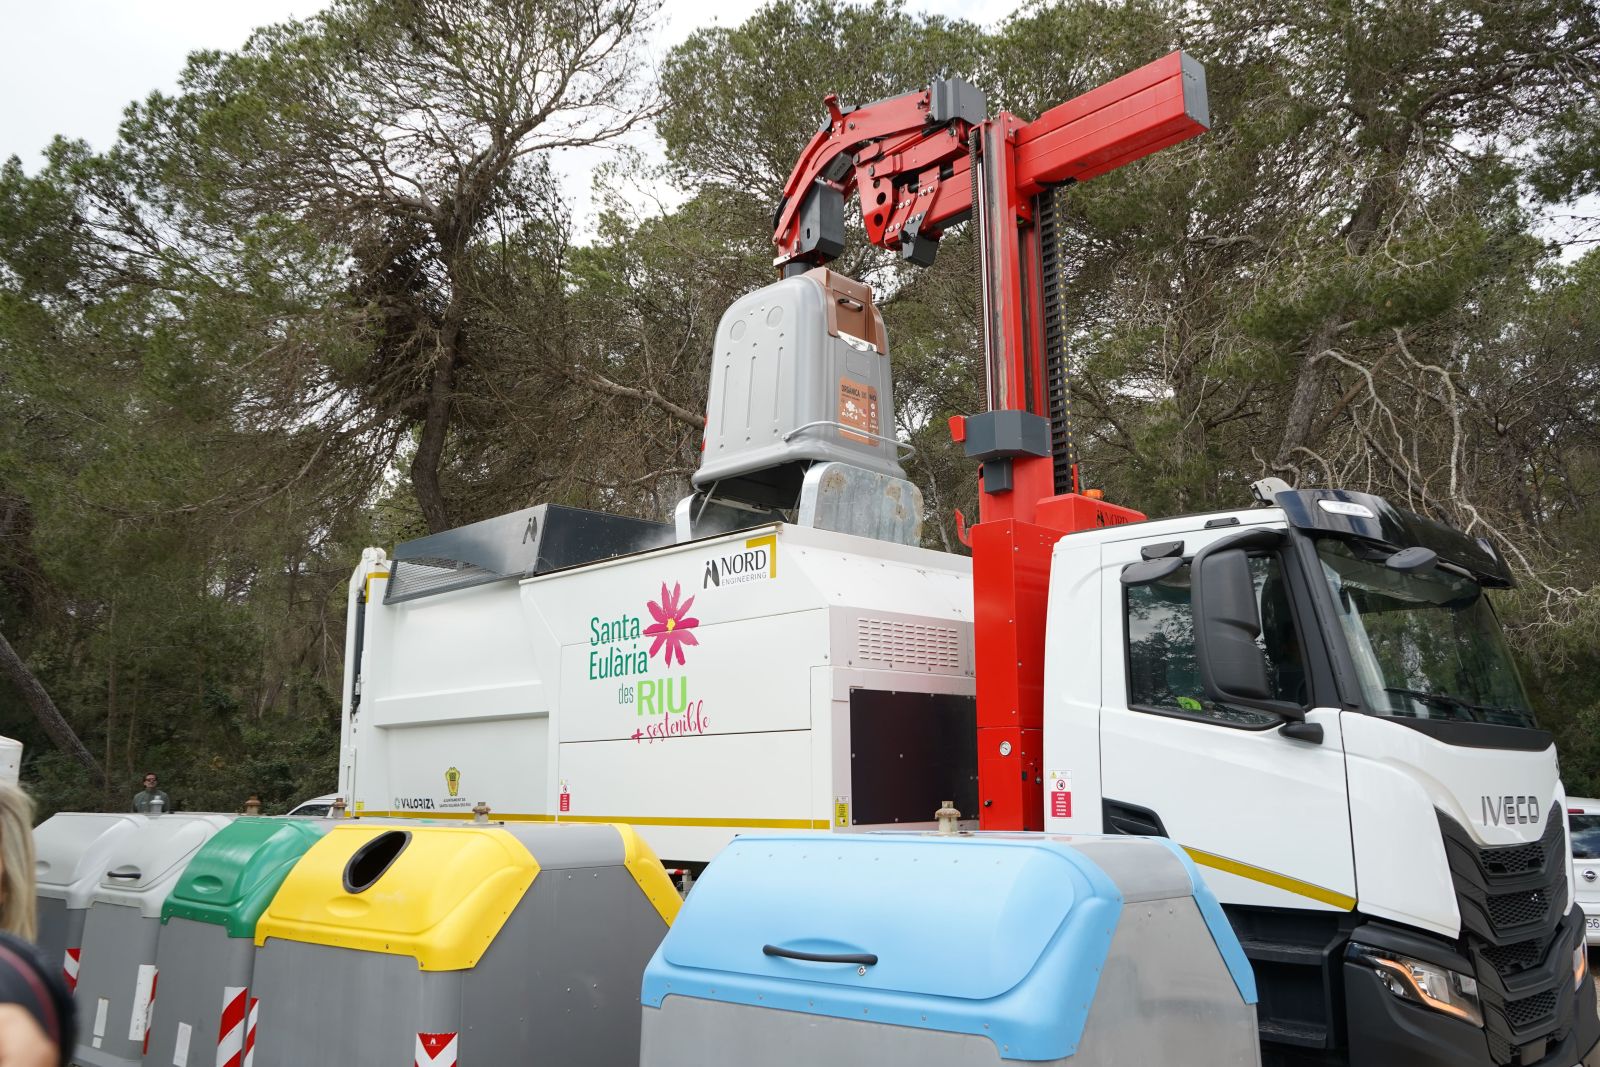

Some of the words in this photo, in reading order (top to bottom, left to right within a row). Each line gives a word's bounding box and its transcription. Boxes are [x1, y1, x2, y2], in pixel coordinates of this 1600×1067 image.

[721, 549, 767, 576] NORD
[721, 572, 767, 587] ENGINEERING
[590, 614, 640, 646] Santa
[589, 643, 648, 681] Eulària
[618, 683, 634, 705] des
[637, 675, 688, 717] RIU
[646, 699, 711, 744] sostenible
[401, 798, 435, 810] VALORIZA
[1481, 795, 1540, 827] IVECO
